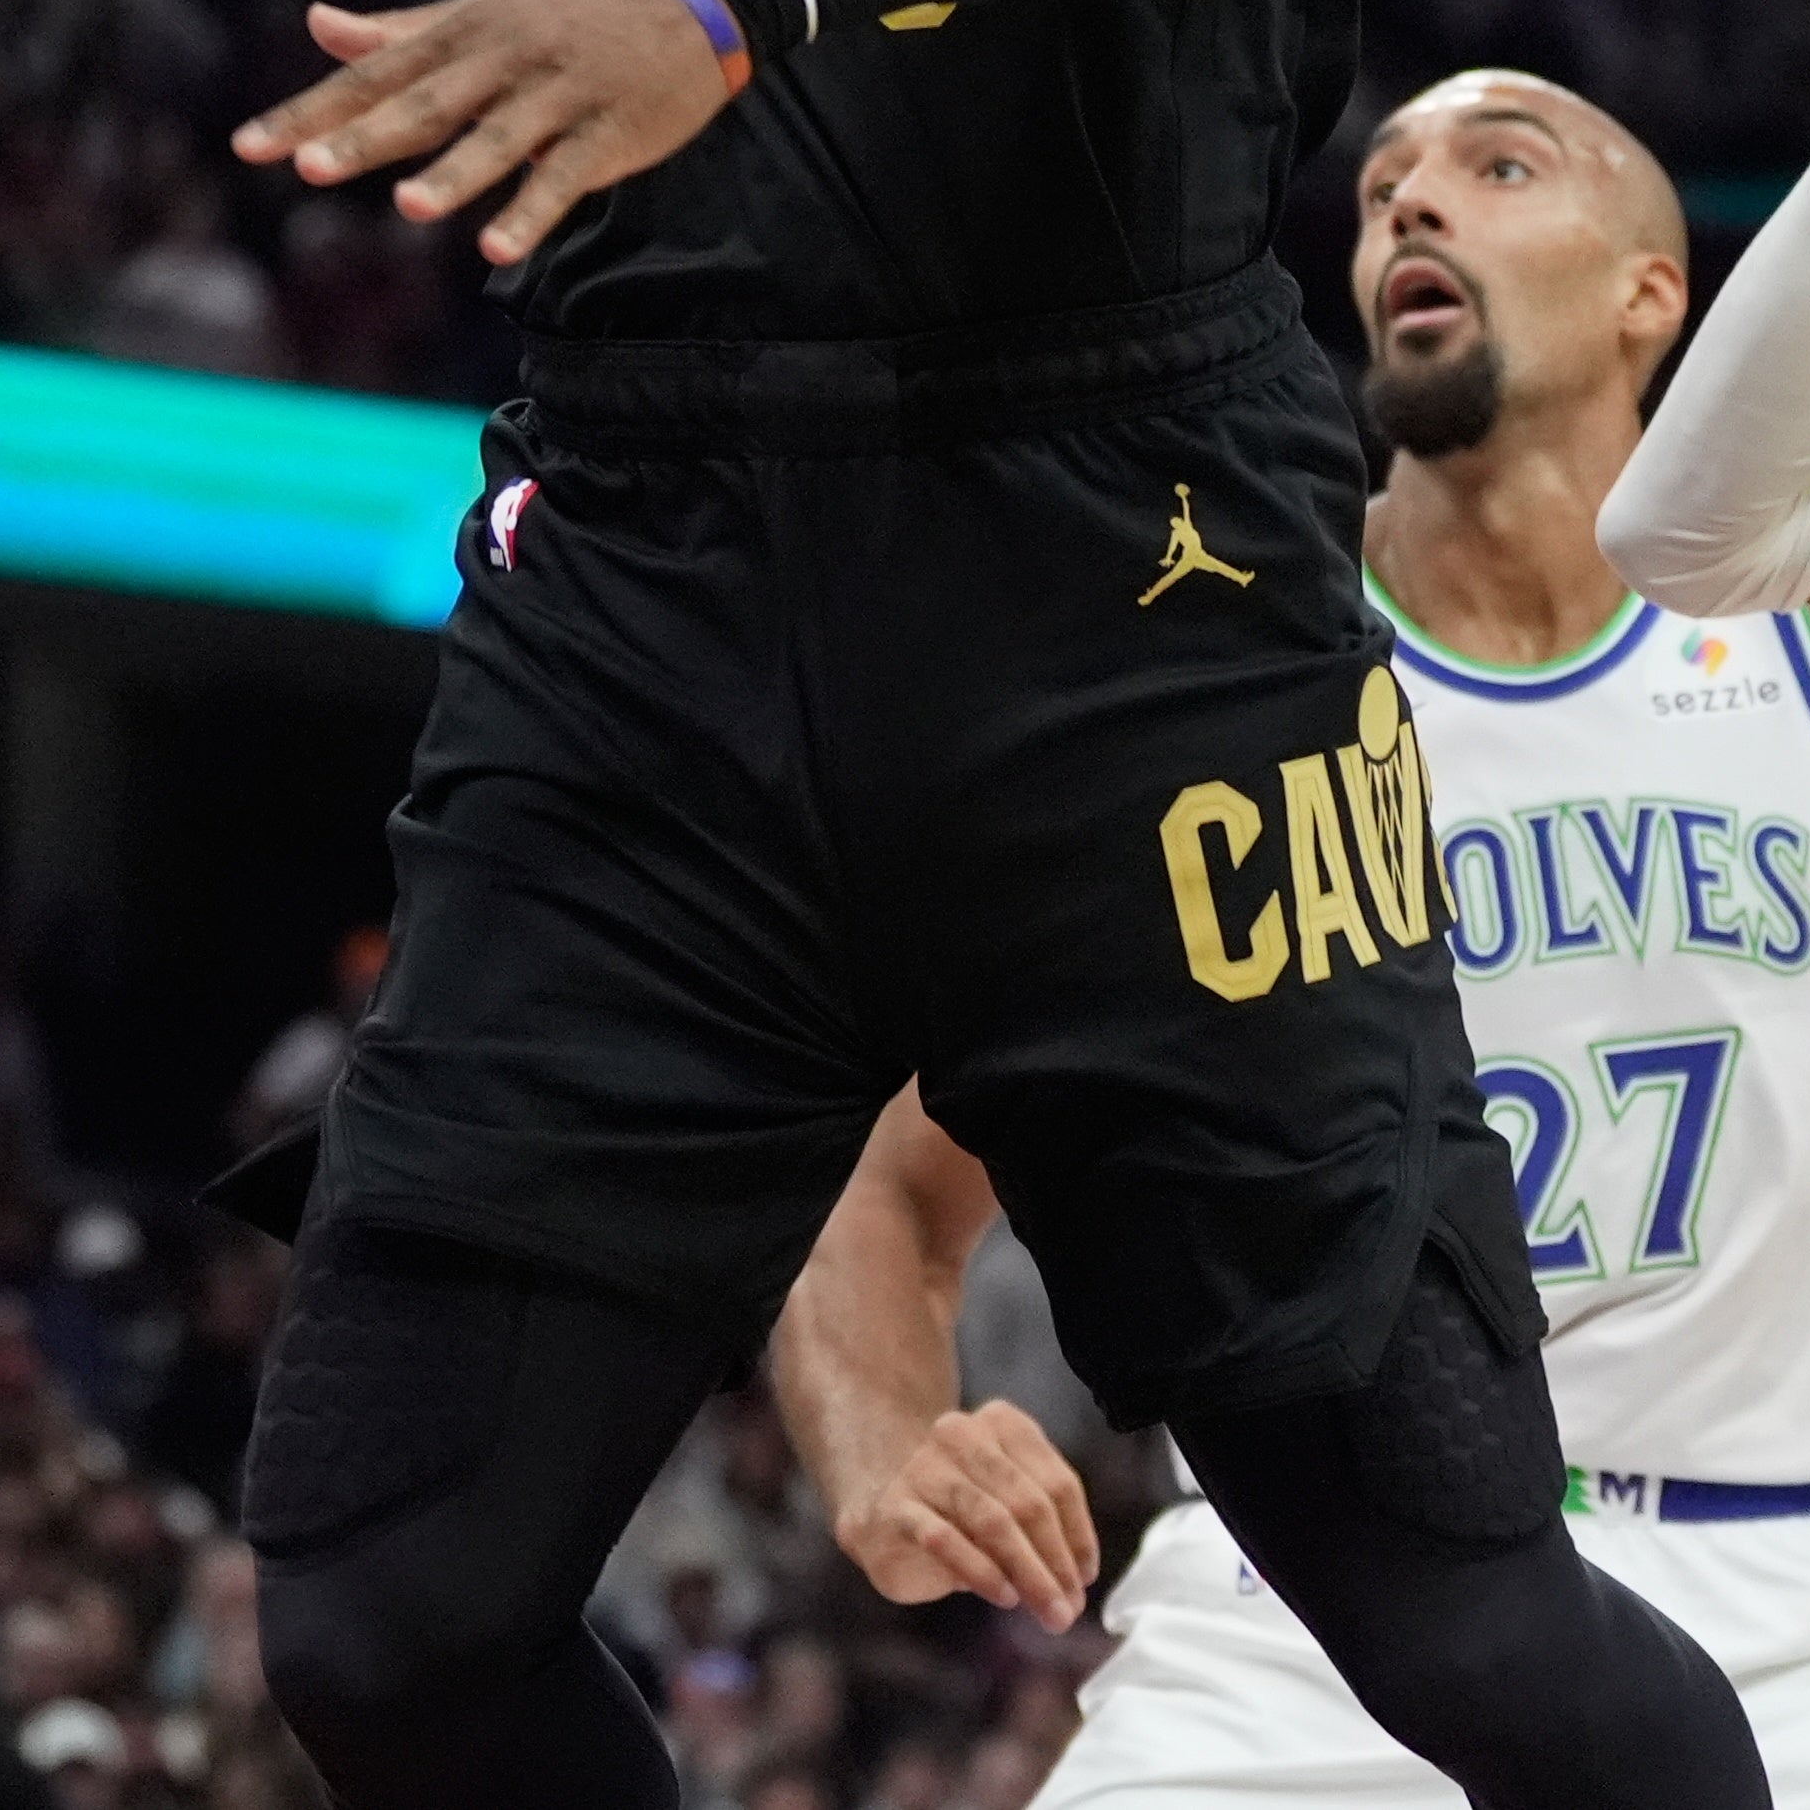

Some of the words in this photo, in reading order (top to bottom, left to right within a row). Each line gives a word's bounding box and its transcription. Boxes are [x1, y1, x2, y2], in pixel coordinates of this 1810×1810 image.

[1651, 673, 1781, 717] sezzle
[1158, 665, 1458, 1003] CAV
[1474, 1028, 1742, 1287] 27
